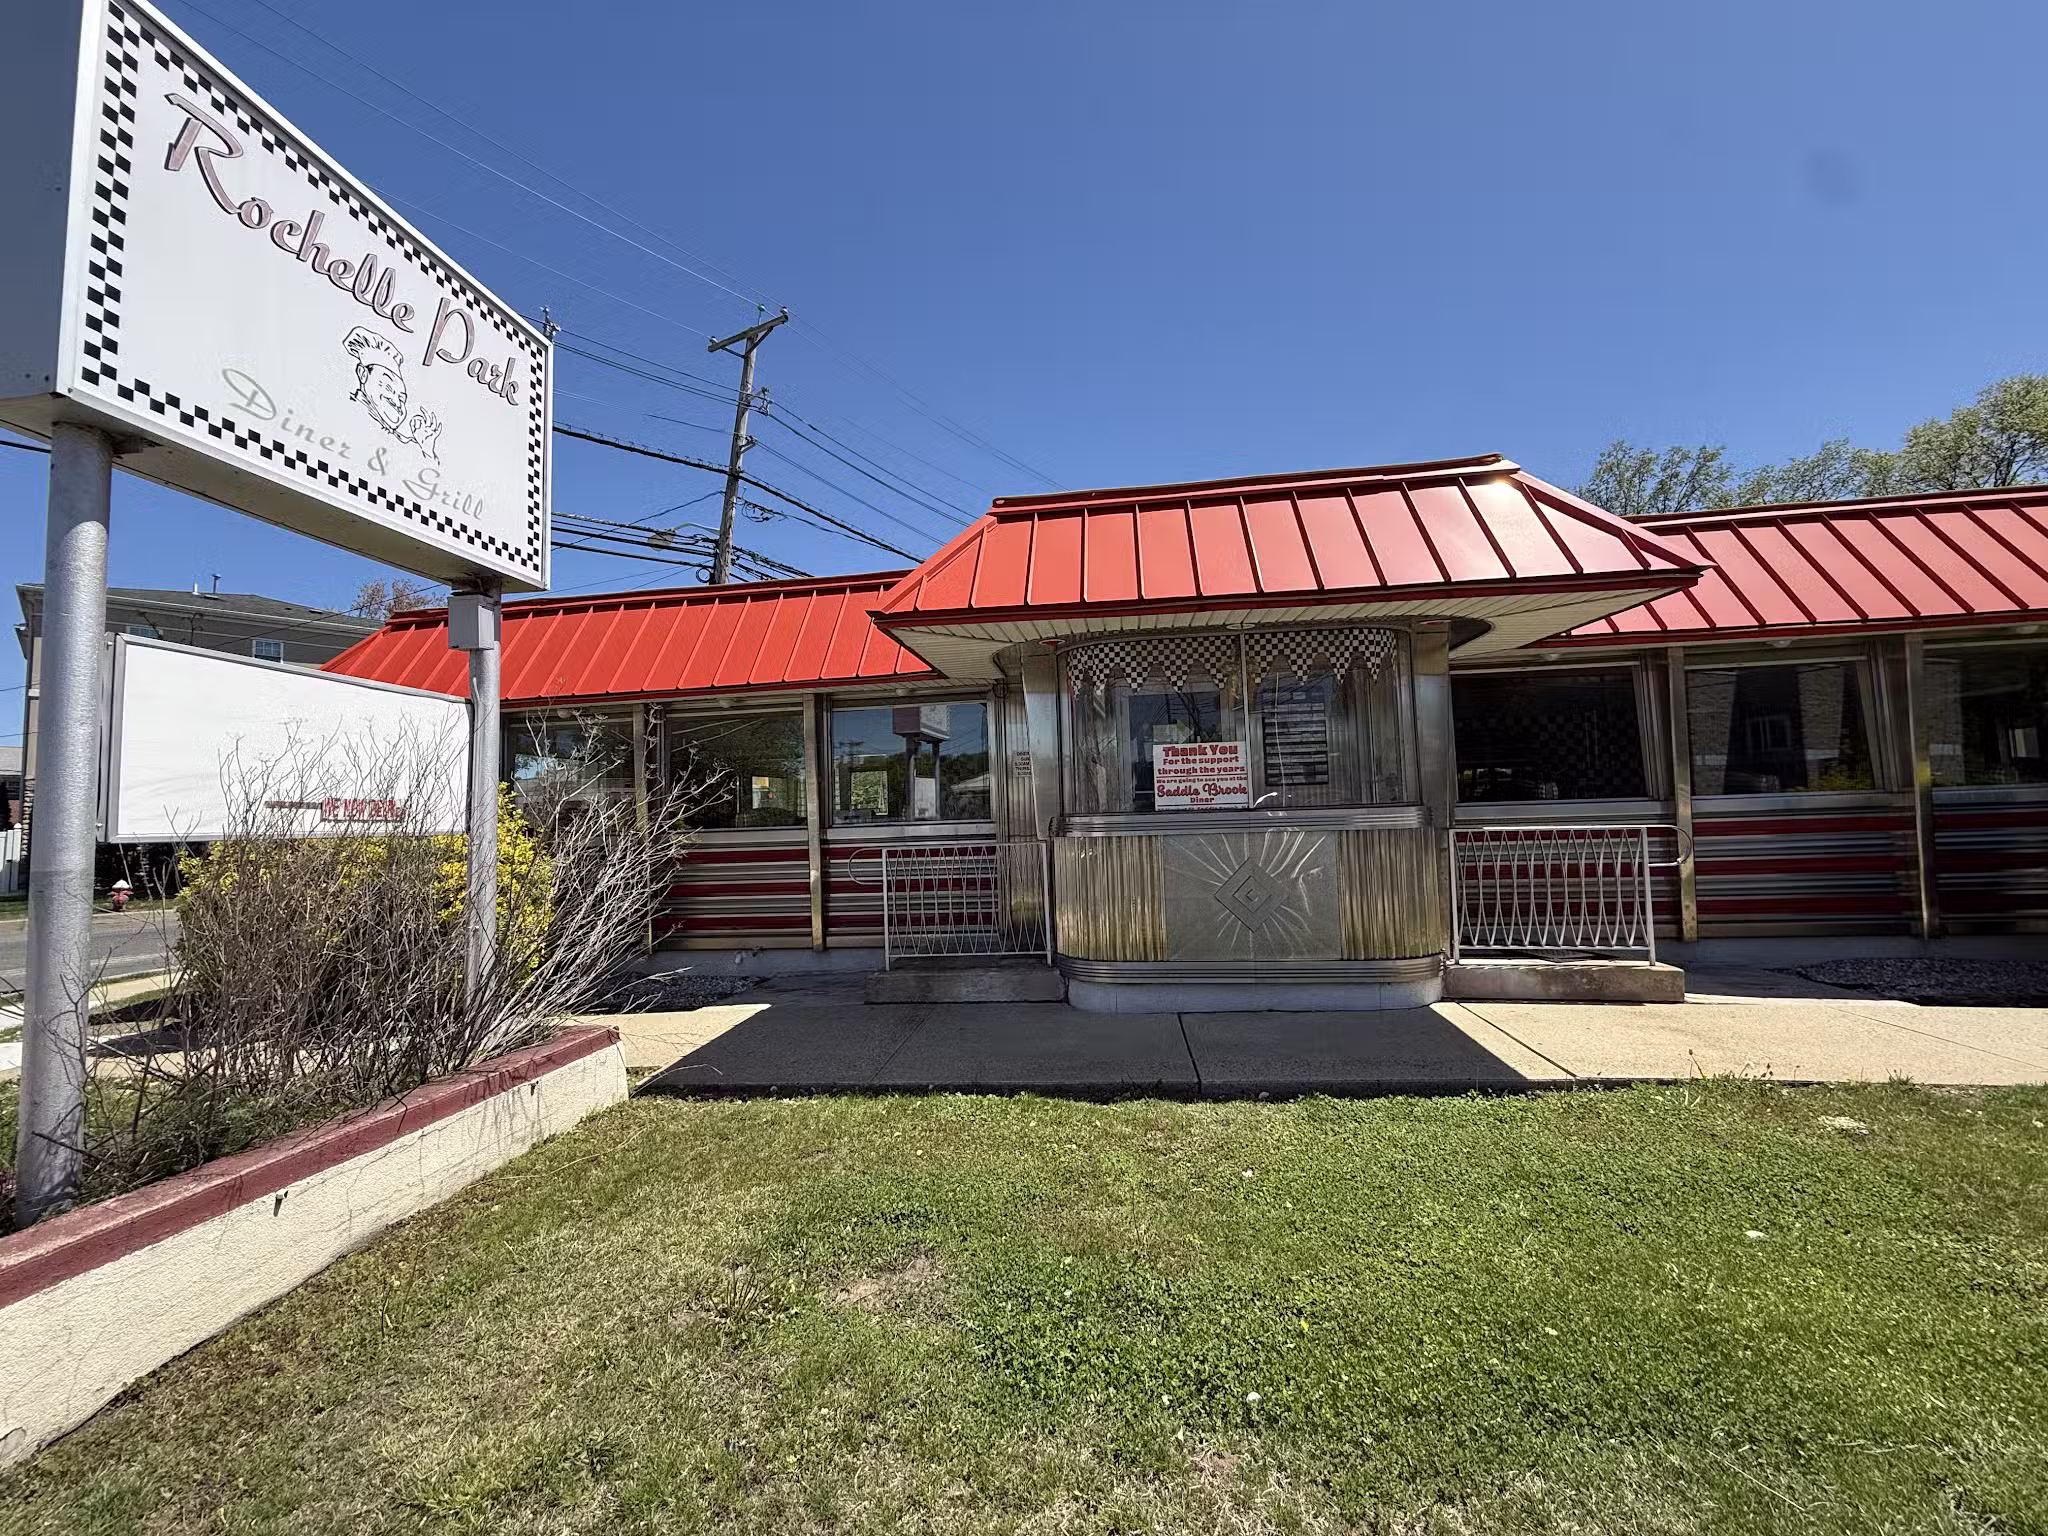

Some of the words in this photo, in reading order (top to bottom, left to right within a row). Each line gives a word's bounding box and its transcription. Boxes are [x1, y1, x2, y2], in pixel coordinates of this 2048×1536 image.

[164, 93, 415, 333] Rochelle
[422, 297, 519, 406] Park
[222, 368, 351, 458] Diner
[367, 447, 388, 477] &
[402, 467, 484, 520] Grill
[1163, 745, 1208, 757] Thank
[1209, 745, 1238, 755] You
[1181, 757, 1197, 765] the
[1198, 755, 1239, 764] support
[1157, 766, 1198, 775] through
[1216, 765, 1245, 773] years
[1156, 784, 1200, 797] Saddle
[1202, 783, 1248, 796] Brook
